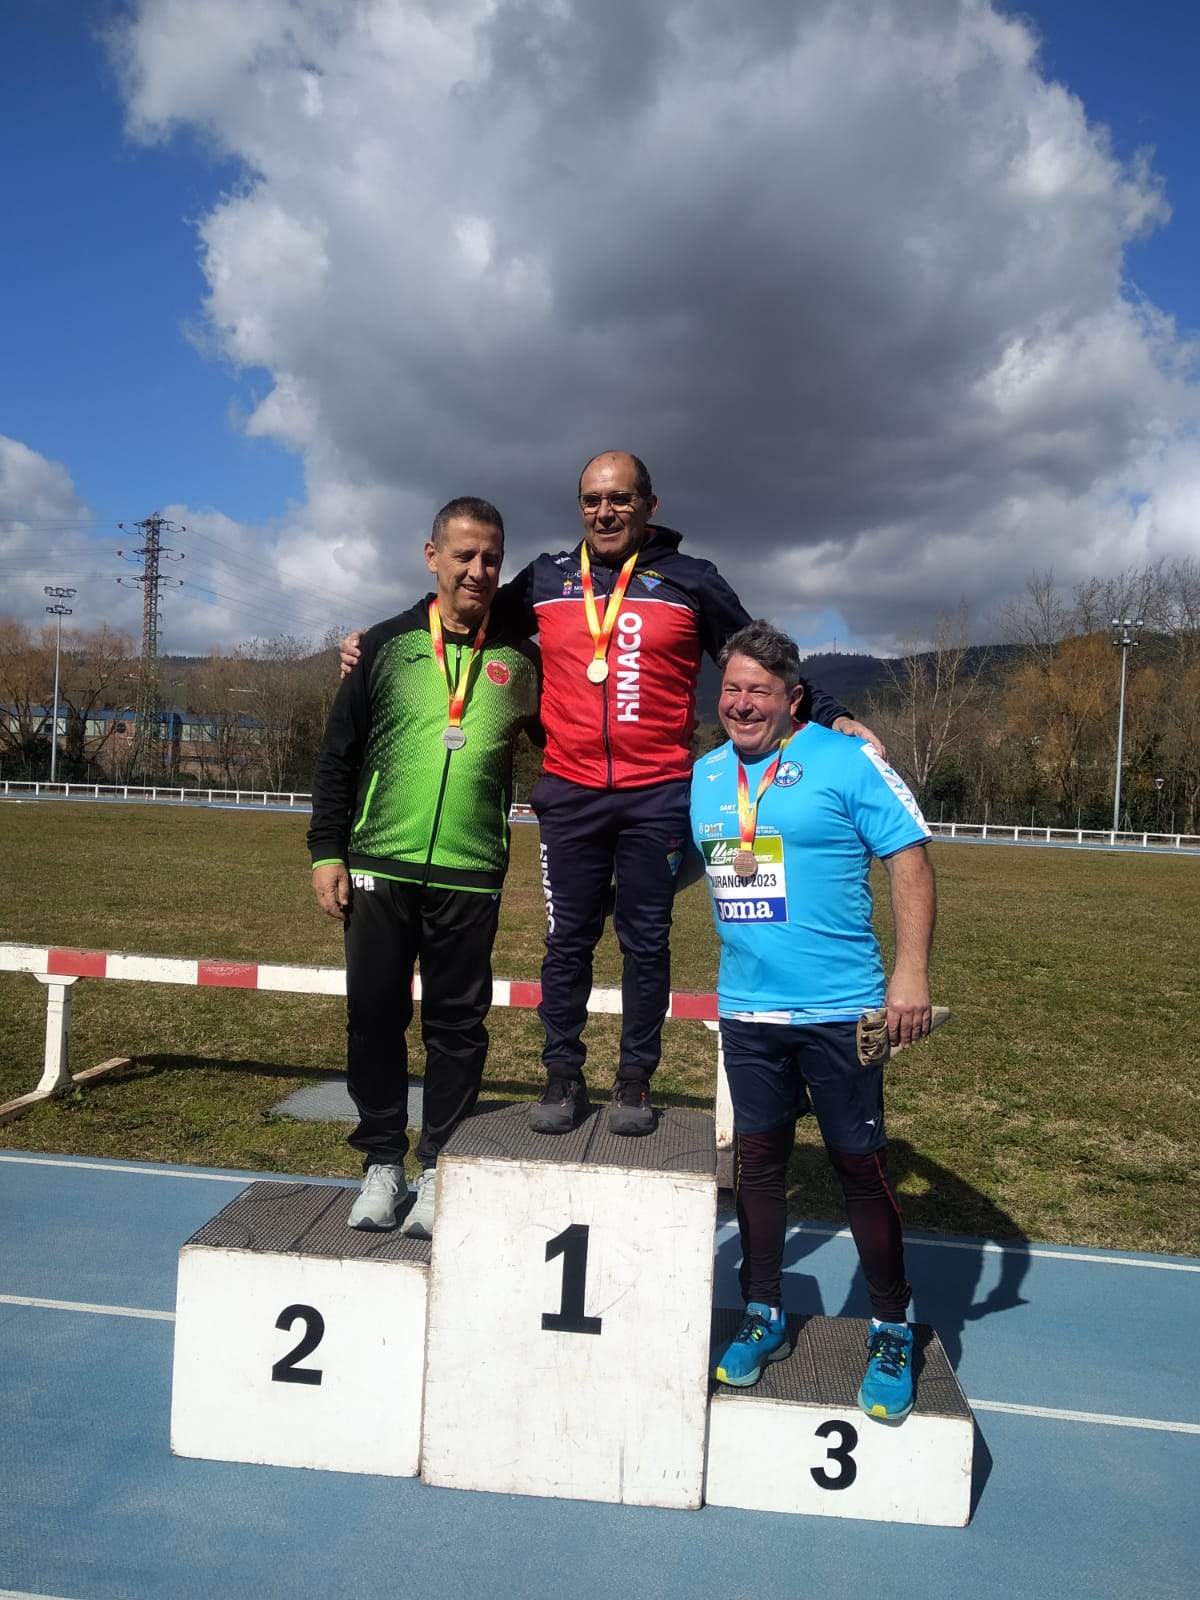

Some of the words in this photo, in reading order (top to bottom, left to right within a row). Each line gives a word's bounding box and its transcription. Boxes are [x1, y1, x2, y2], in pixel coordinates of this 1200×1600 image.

[750, 873, 777, 888] 2023
[540, 1223, 602, 1336] 1
[271, 1303, 326, 1386] 2
[809, 1419, 859, 1491] 3
